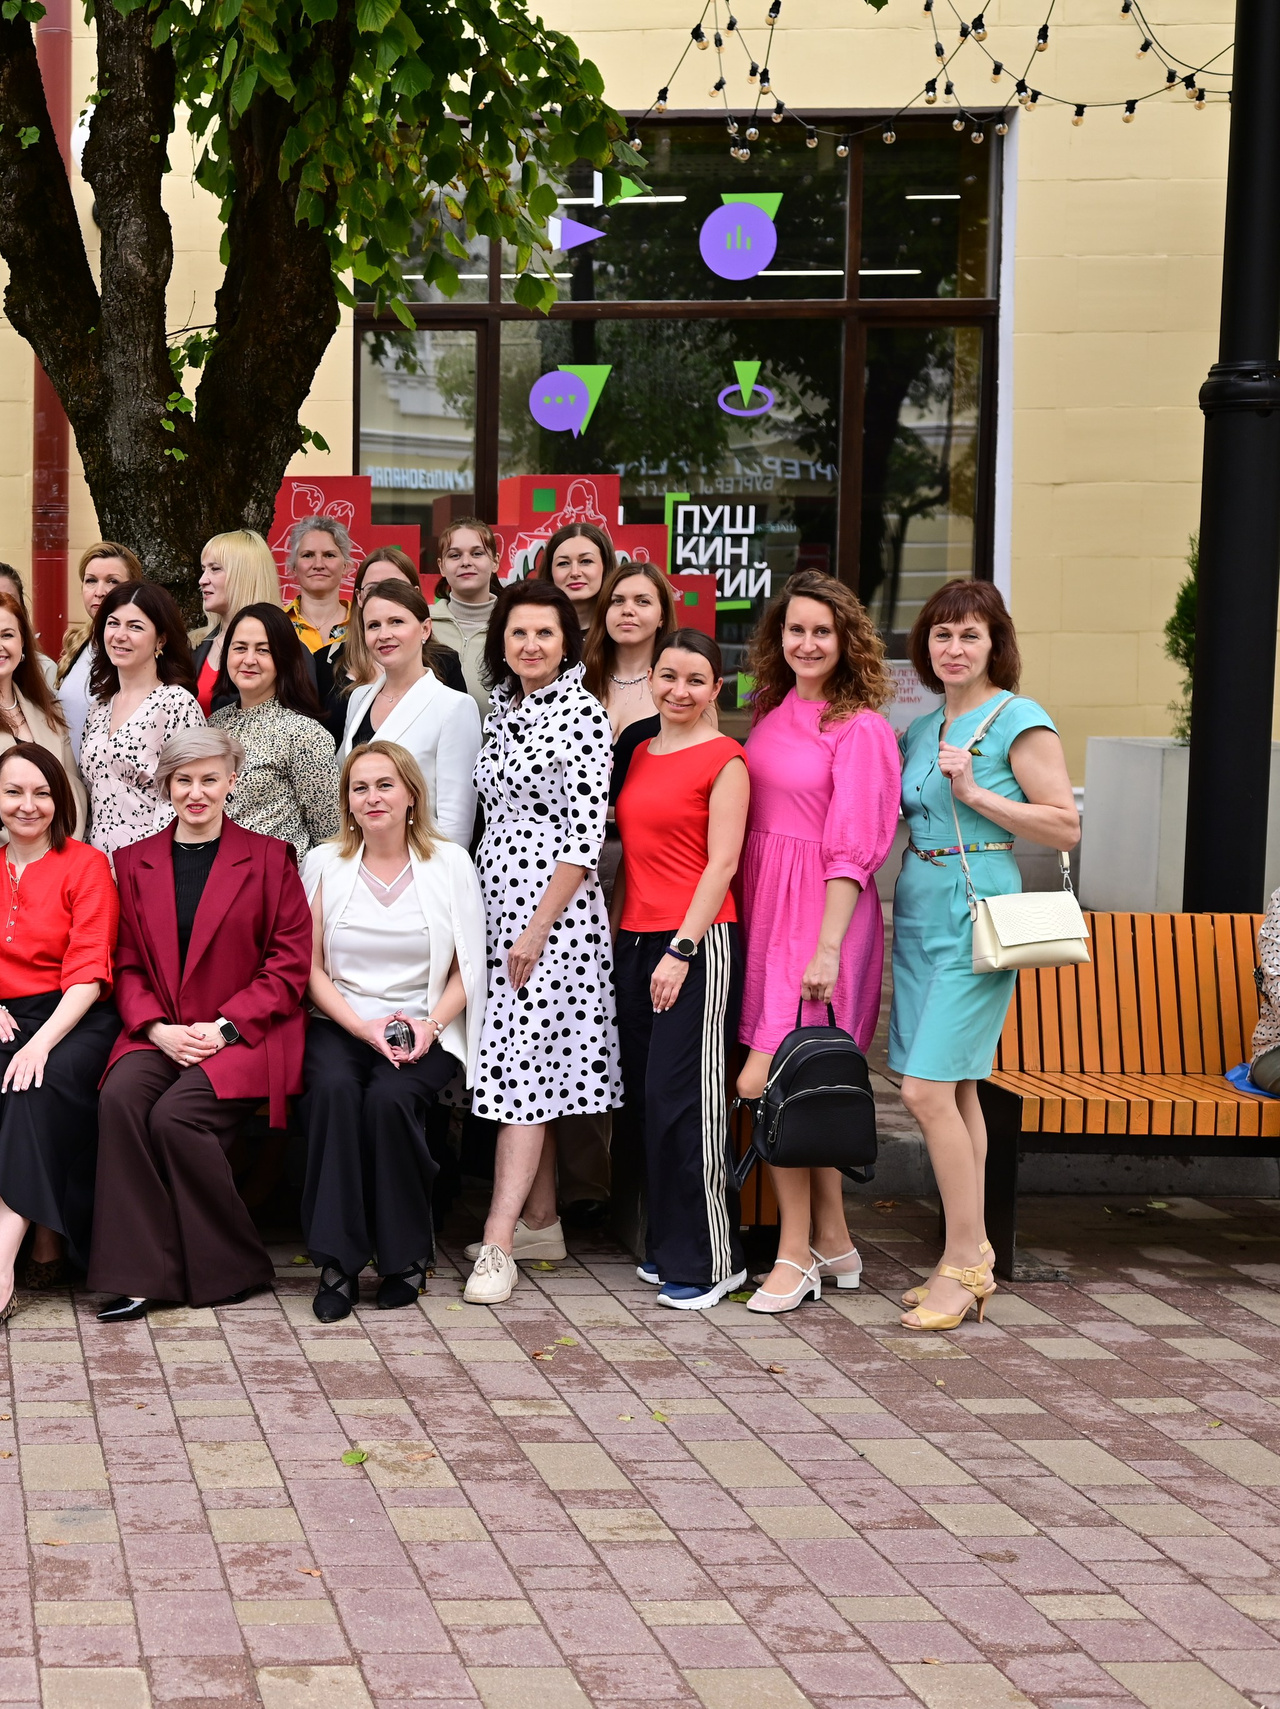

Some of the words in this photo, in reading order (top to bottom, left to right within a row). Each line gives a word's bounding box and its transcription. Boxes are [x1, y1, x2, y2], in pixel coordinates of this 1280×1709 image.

[677, 504, 756, 535] ПУШ
[676, 536, 749, 566] КИН
[898, 696, 923, 704] ЗИМУ
